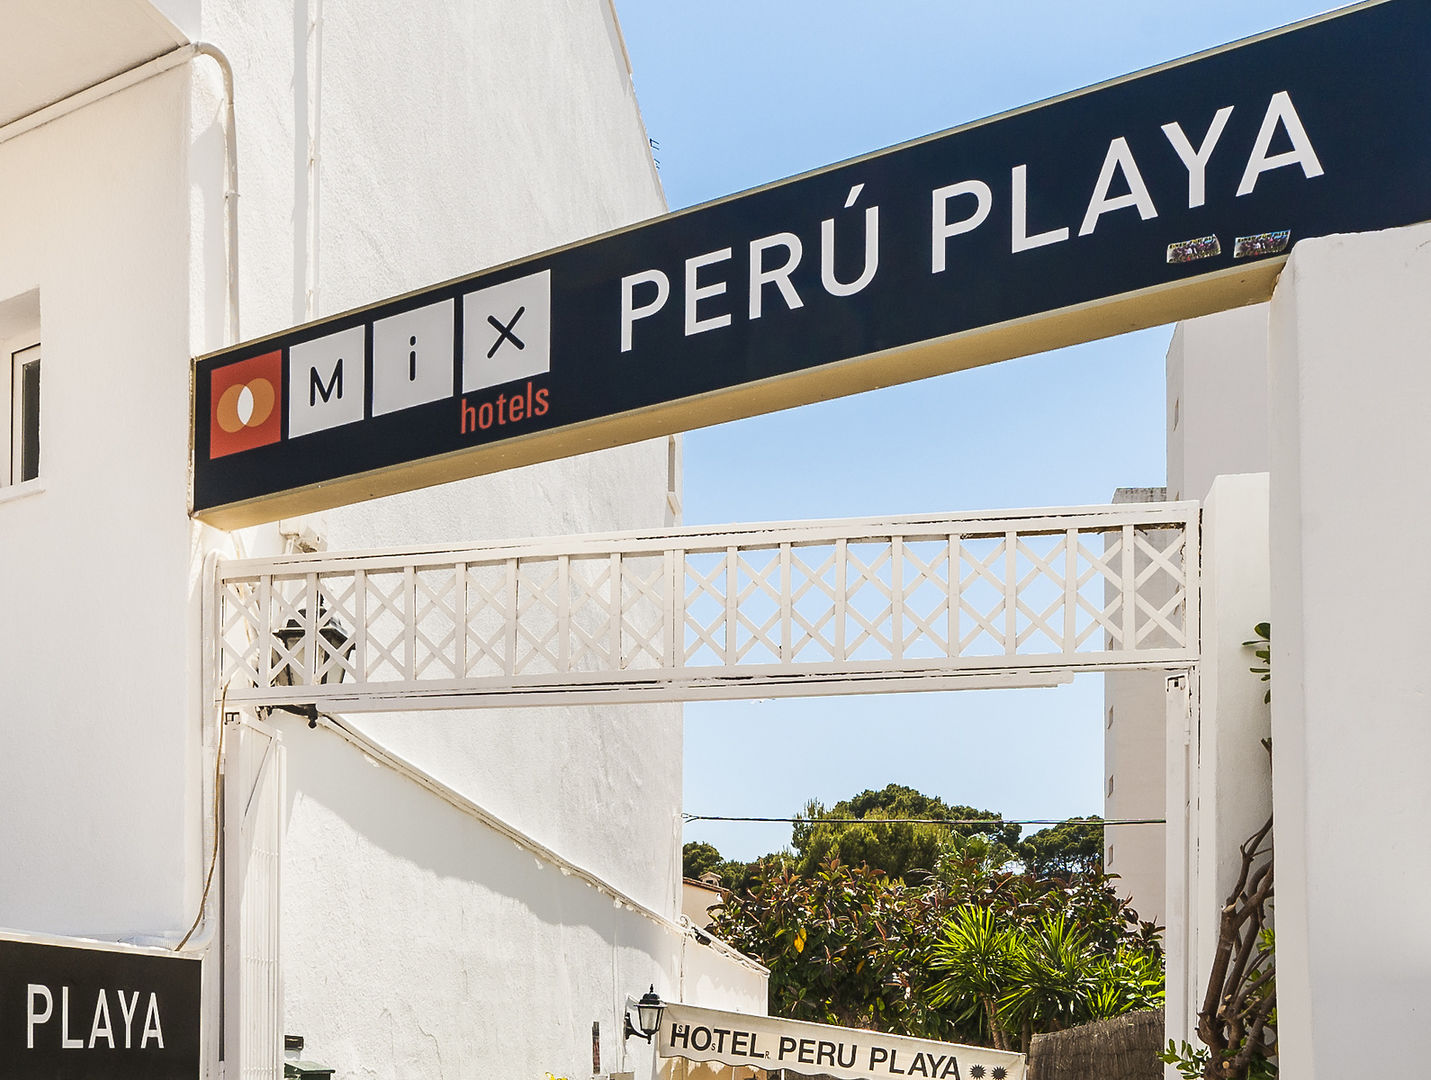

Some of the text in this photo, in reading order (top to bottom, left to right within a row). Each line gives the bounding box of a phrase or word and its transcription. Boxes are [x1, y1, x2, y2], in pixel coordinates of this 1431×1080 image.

[620, 90, 1326, 353] PERÚ PLAYA
[461, 382, 549, 434] hotels
[27, 983, 165, 1049] PLAYA
[670, 1023, 765, 1059] HOTEL
[778, 1036, 858, 1069] PERU
